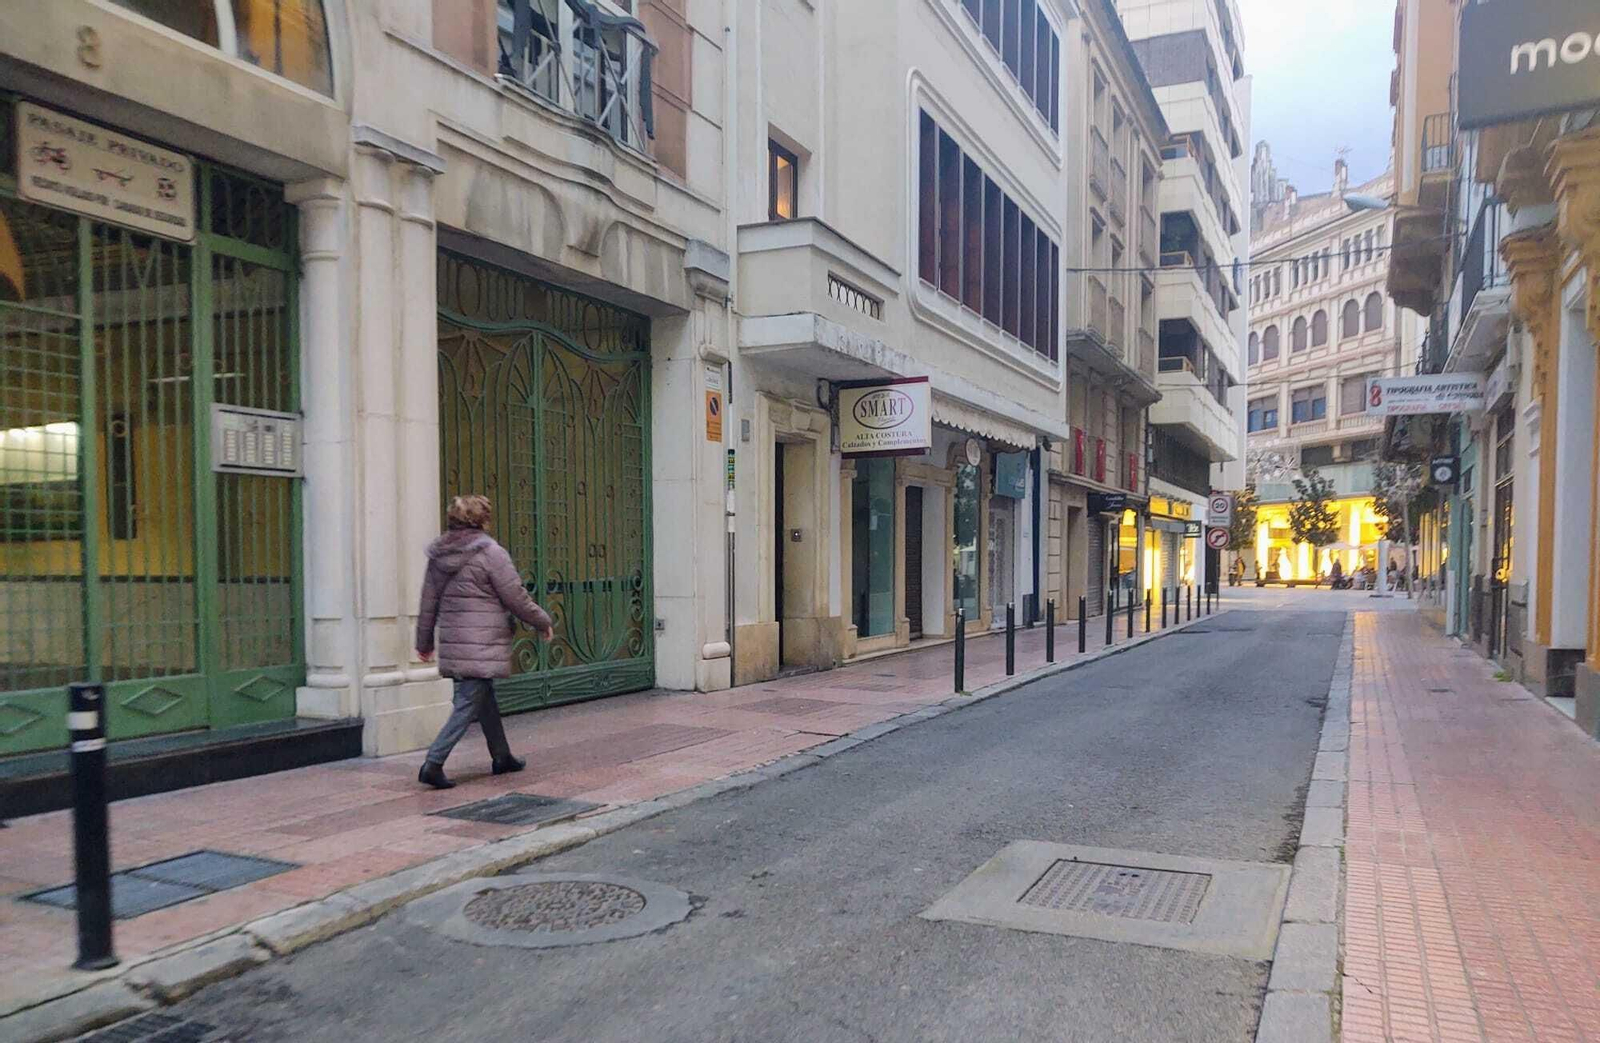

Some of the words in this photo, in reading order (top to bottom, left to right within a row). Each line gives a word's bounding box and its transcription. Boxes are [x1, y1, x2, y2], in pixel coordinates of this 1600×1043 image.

[1510, 31, 1600, 75] mo
[860, 397, 906, 418] SMART
[842, 440, 871, 449] Calzados
[878, 437, 927, 447] Complementos
[856, 433, 875, 441] ALTA
[875, 431, 913, 439] COSTURA
